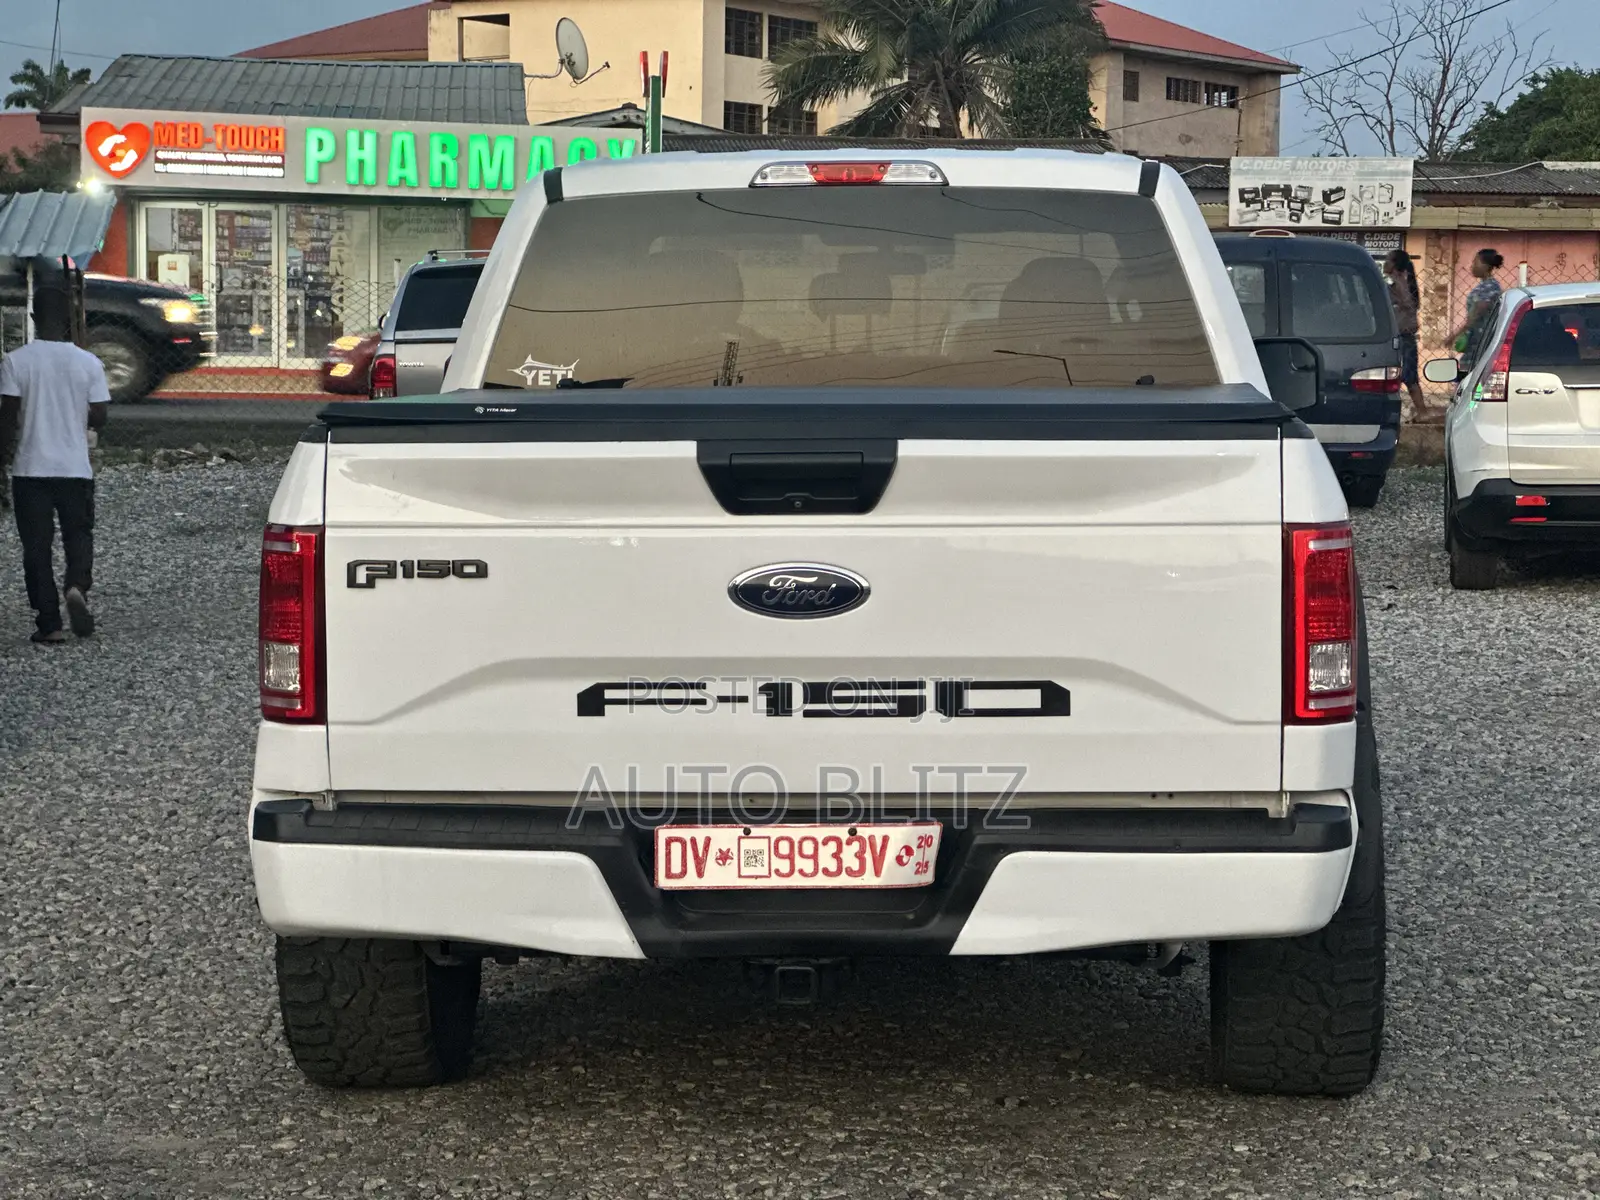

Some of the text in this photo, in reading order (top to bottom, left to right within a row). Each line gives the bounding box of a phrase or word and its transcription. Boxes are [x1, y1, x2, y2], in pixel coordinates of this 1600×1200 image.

[153, 121, 285, 152] MED-TOUCH
[1240, 160, 1292, 171] C.DEDE
[1296, 160, 1356, 171] MOTORS
[1364, 240, 1400, 248] MOTORS
[522, 369, 573, 386] YETI
[1515, 387, 1559, 395] CR-V
[346, 559, 489, 589] F150
[762, 574, 837, 606] Ford
[577, 679, 1071, 718] F-150
[664, 834, 891, 879] DV 9933V
